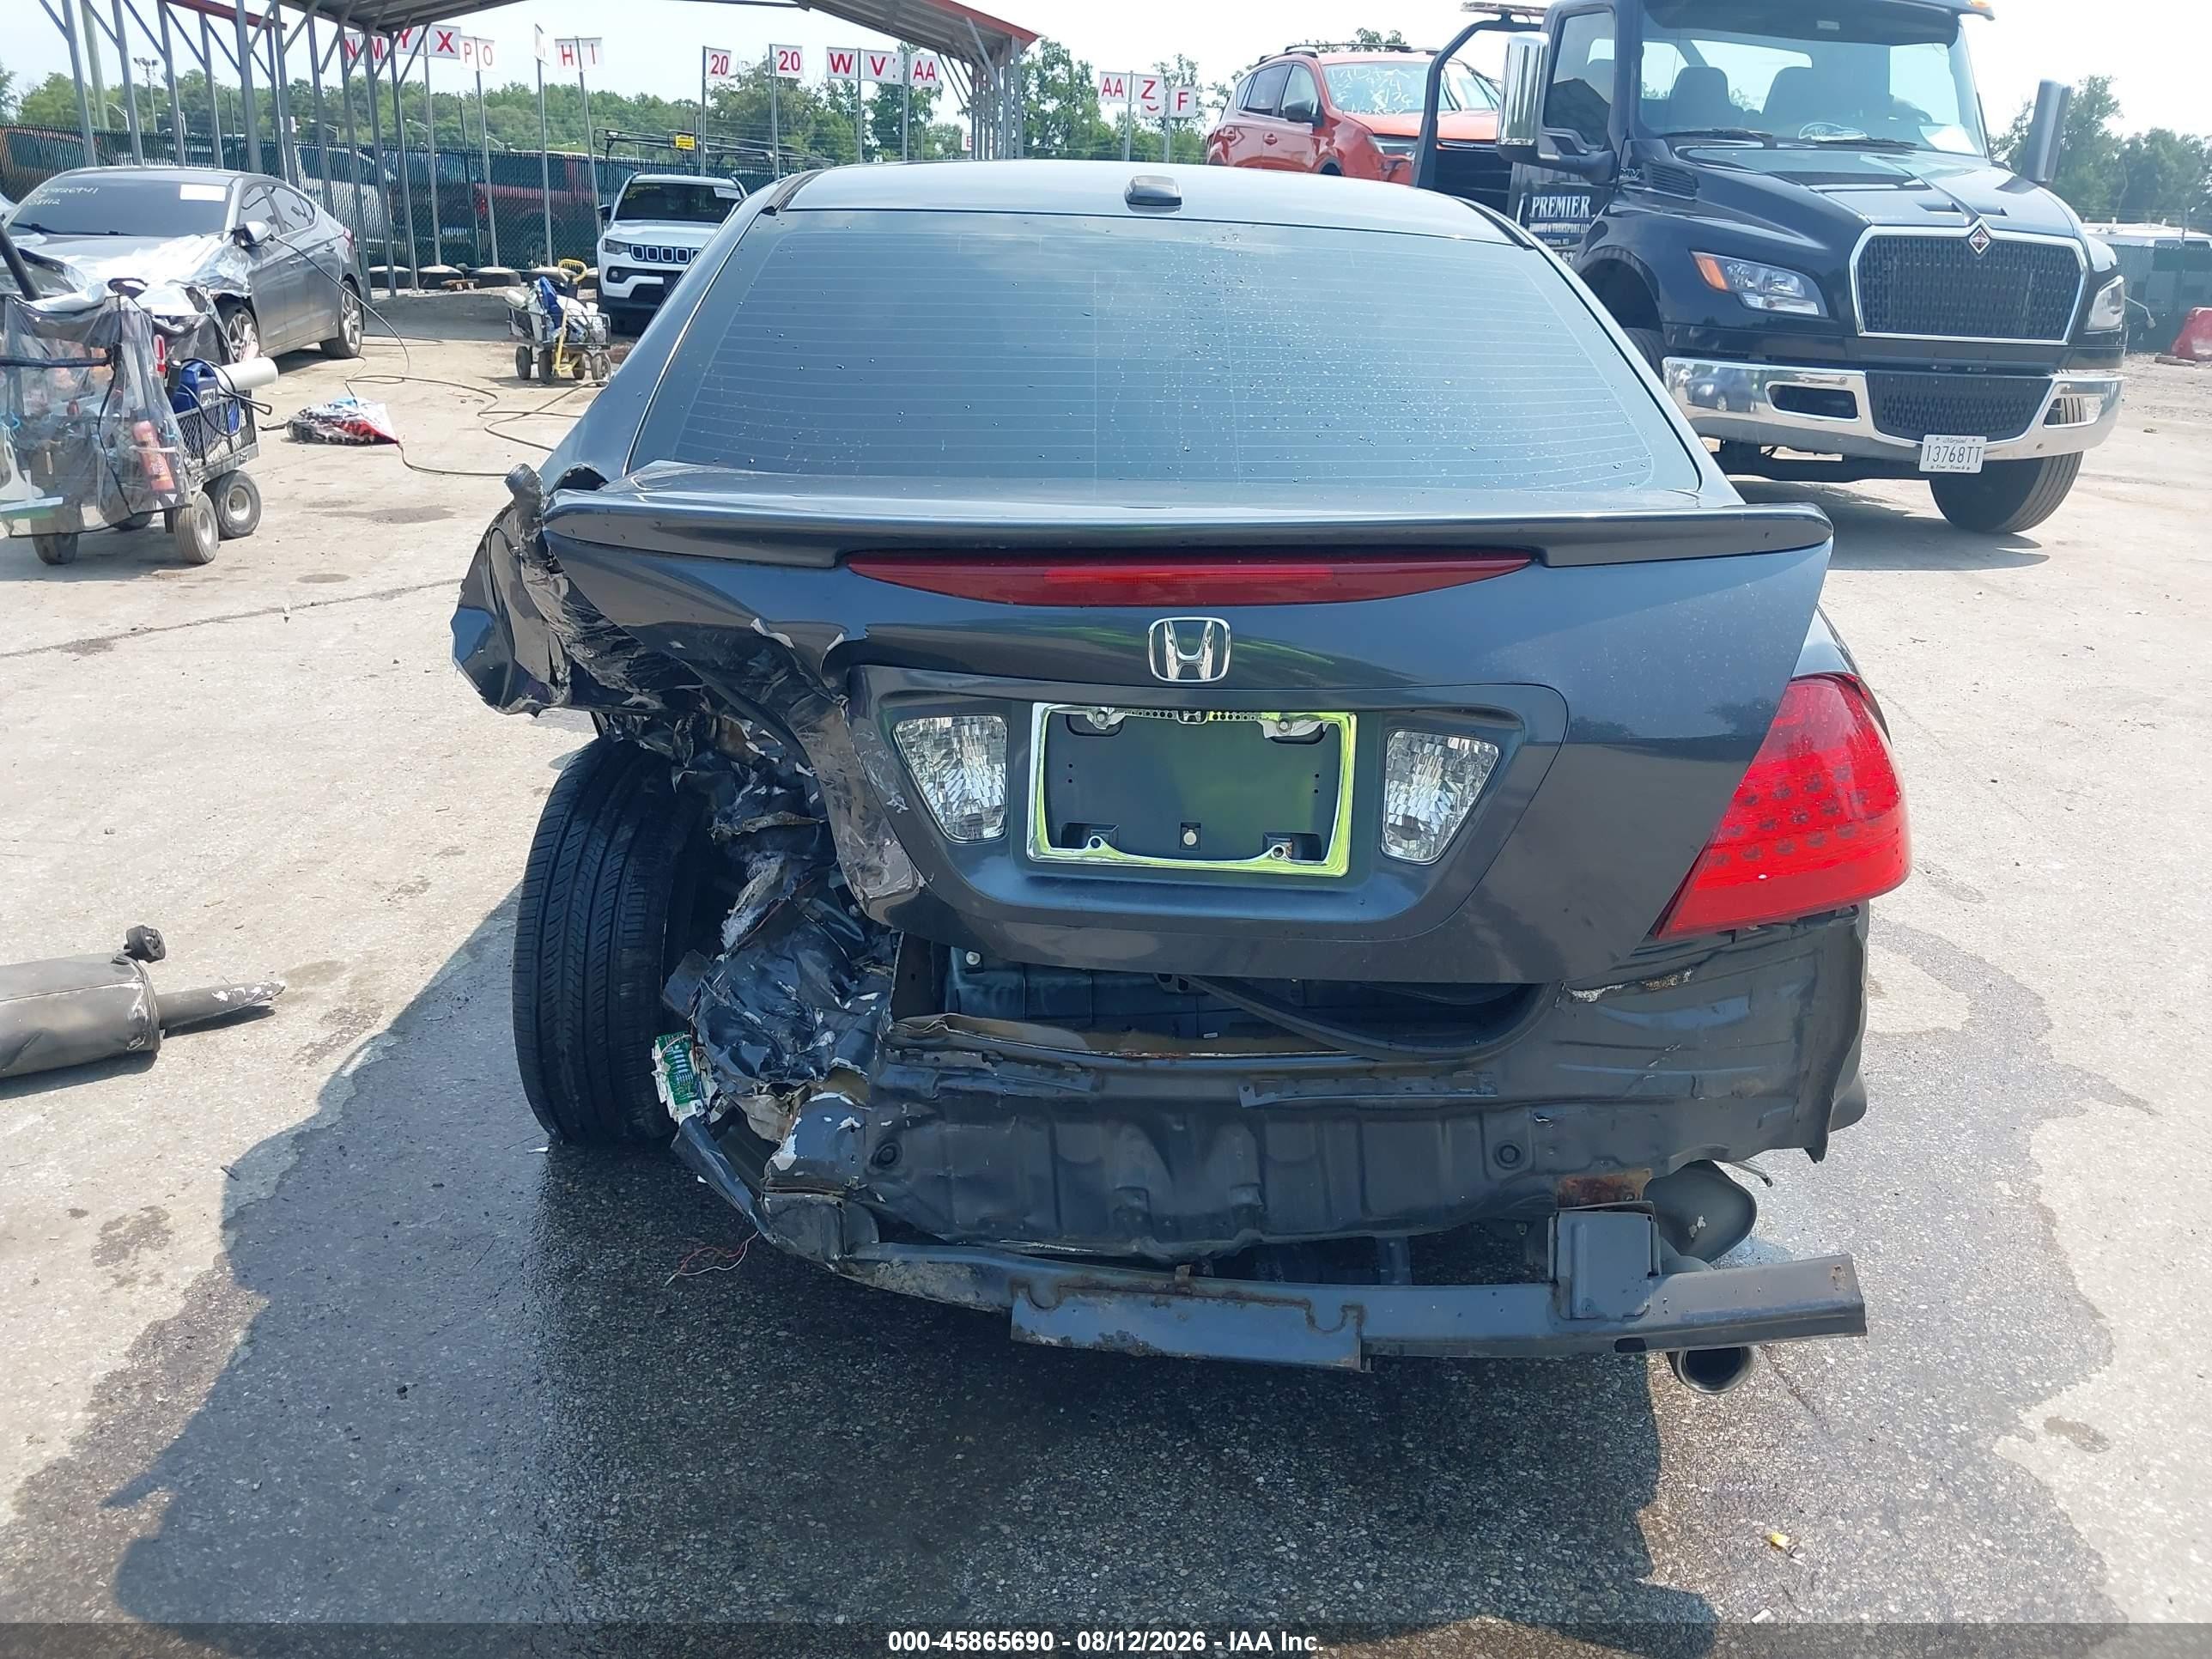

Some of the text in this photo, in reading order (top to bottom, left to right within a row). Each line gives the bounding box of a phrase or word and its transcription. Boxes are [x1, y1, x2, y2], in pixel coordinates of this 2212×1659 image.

[344, 39, 357, 60] N
[436, 30, 455, 53] X
[464, 41, 472, 64] P
[561, 44, 574, 66] H
[779, 51, 801, 71] 20
[830, 52, 854, 74] W
[710, 53, 729, 76] 20
[870, 55, 886, 76] V
[913, 60, 936, 82] AA
[1101, 77, 1124, 98] AA
[1140, 80, 1156, 100] Z
[1177, 92, 1189, 112] F
[1528, 196, 1591, 218] PREMIER
[1926, 445, 1983, 464] 13768TT
